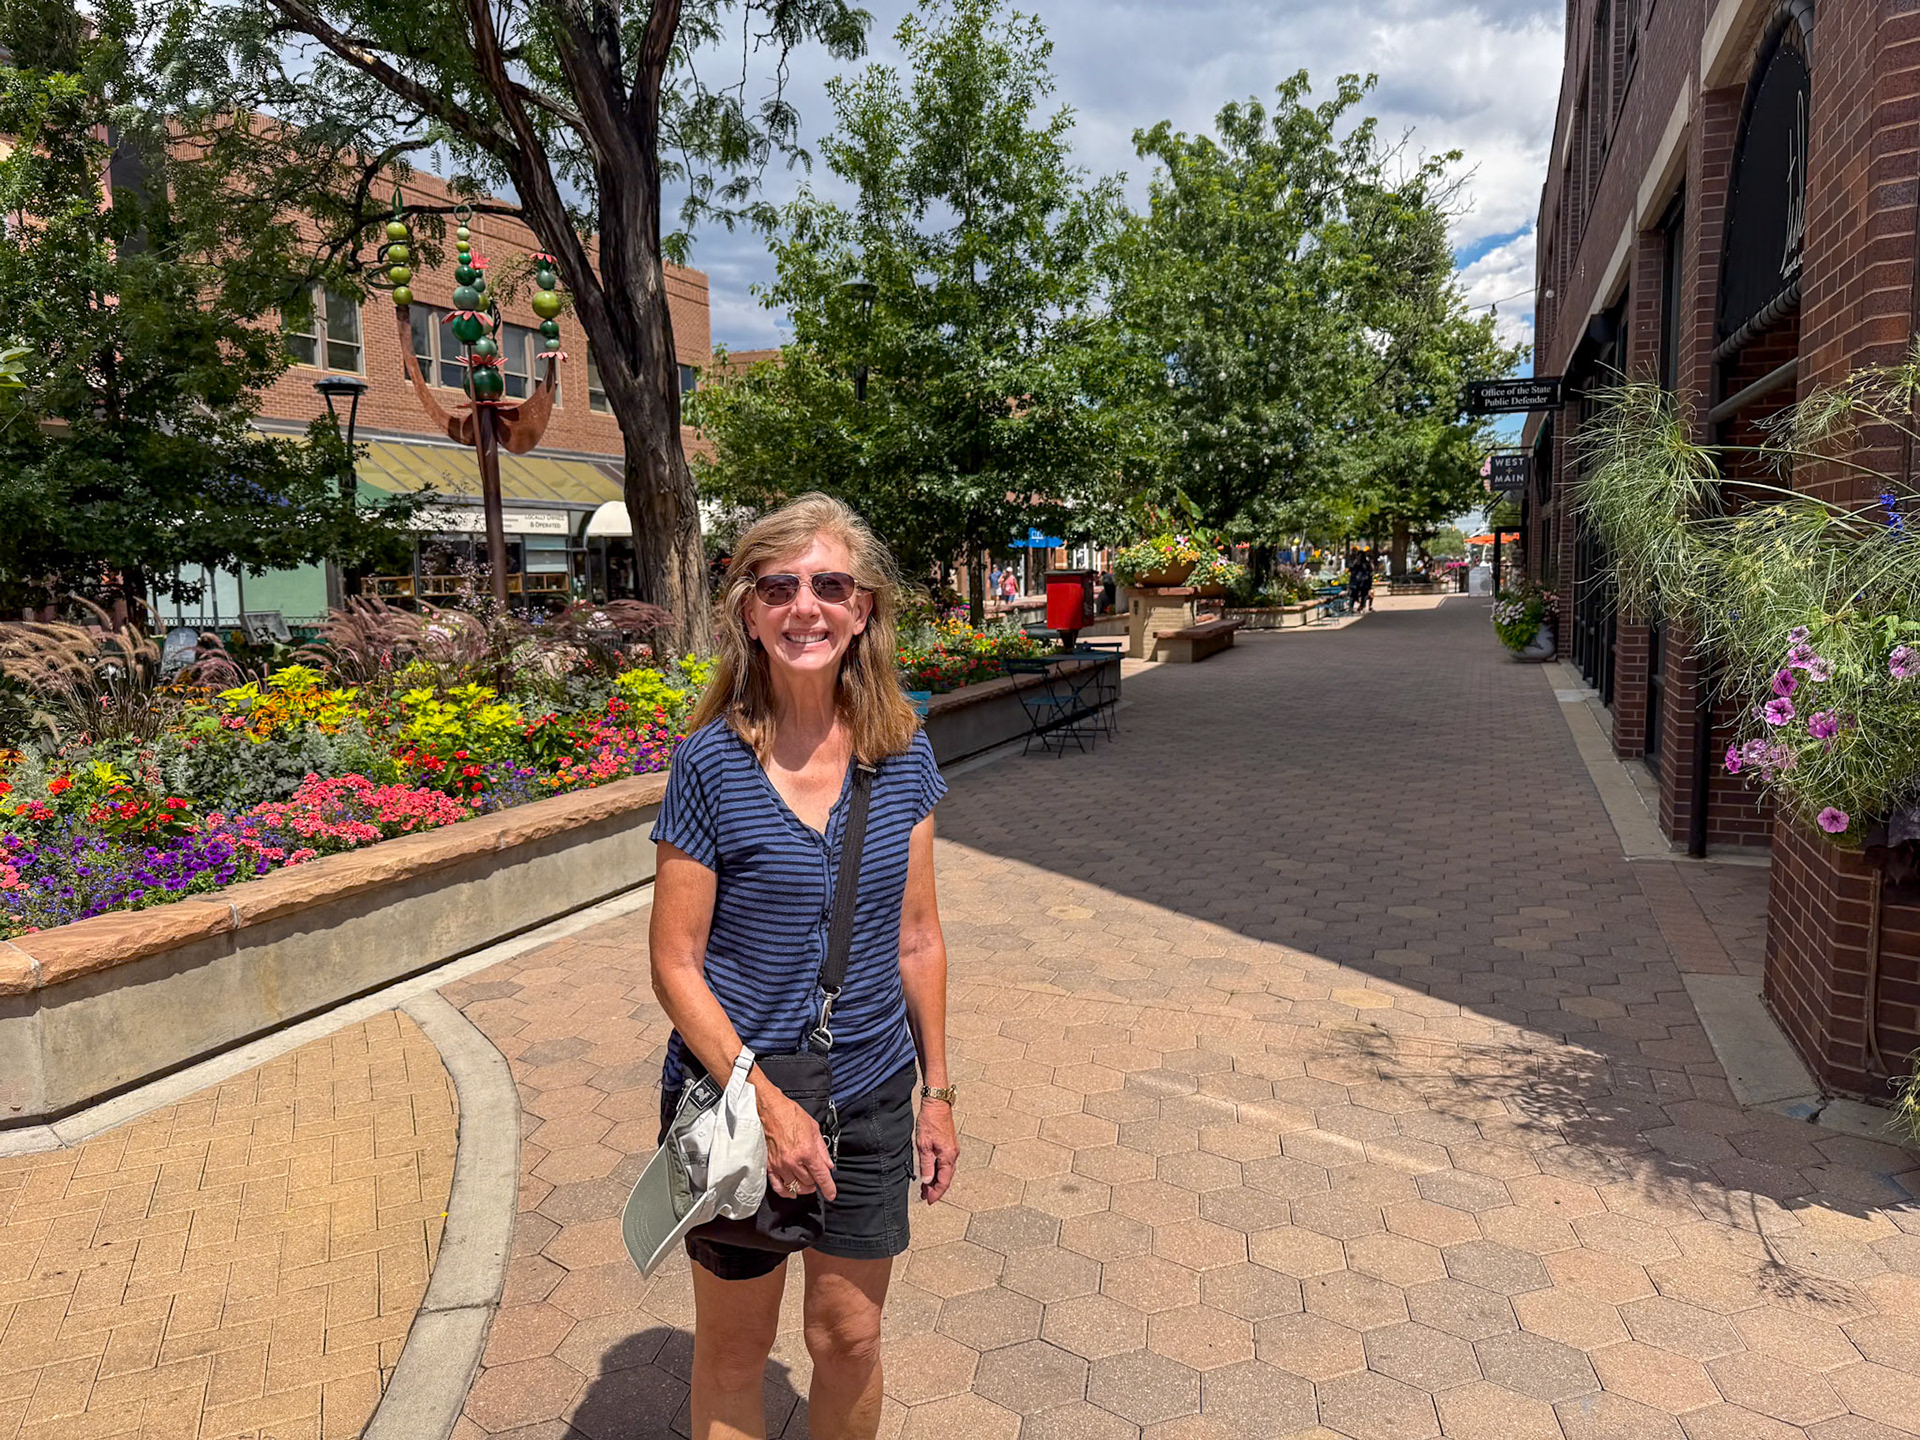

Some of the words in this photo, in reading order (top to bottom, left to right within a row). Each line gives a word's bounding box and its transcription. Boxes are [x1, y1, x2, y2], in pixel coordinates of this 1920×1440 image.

[1481, 388, 1505, 397] Office
[1506, 388, 1516, 396] of
[1517, 386, 1529, 395] the
[1531, 385, 1552, 394] State
[1484, 397, 1510, 407] Public
[1511, 396, 1548, 405] Defender
[1495, 457, 1525, 467] WEST
[1494, 474, 1524, 483] MAIN
[535, 521, 562, 529] OPERATED
